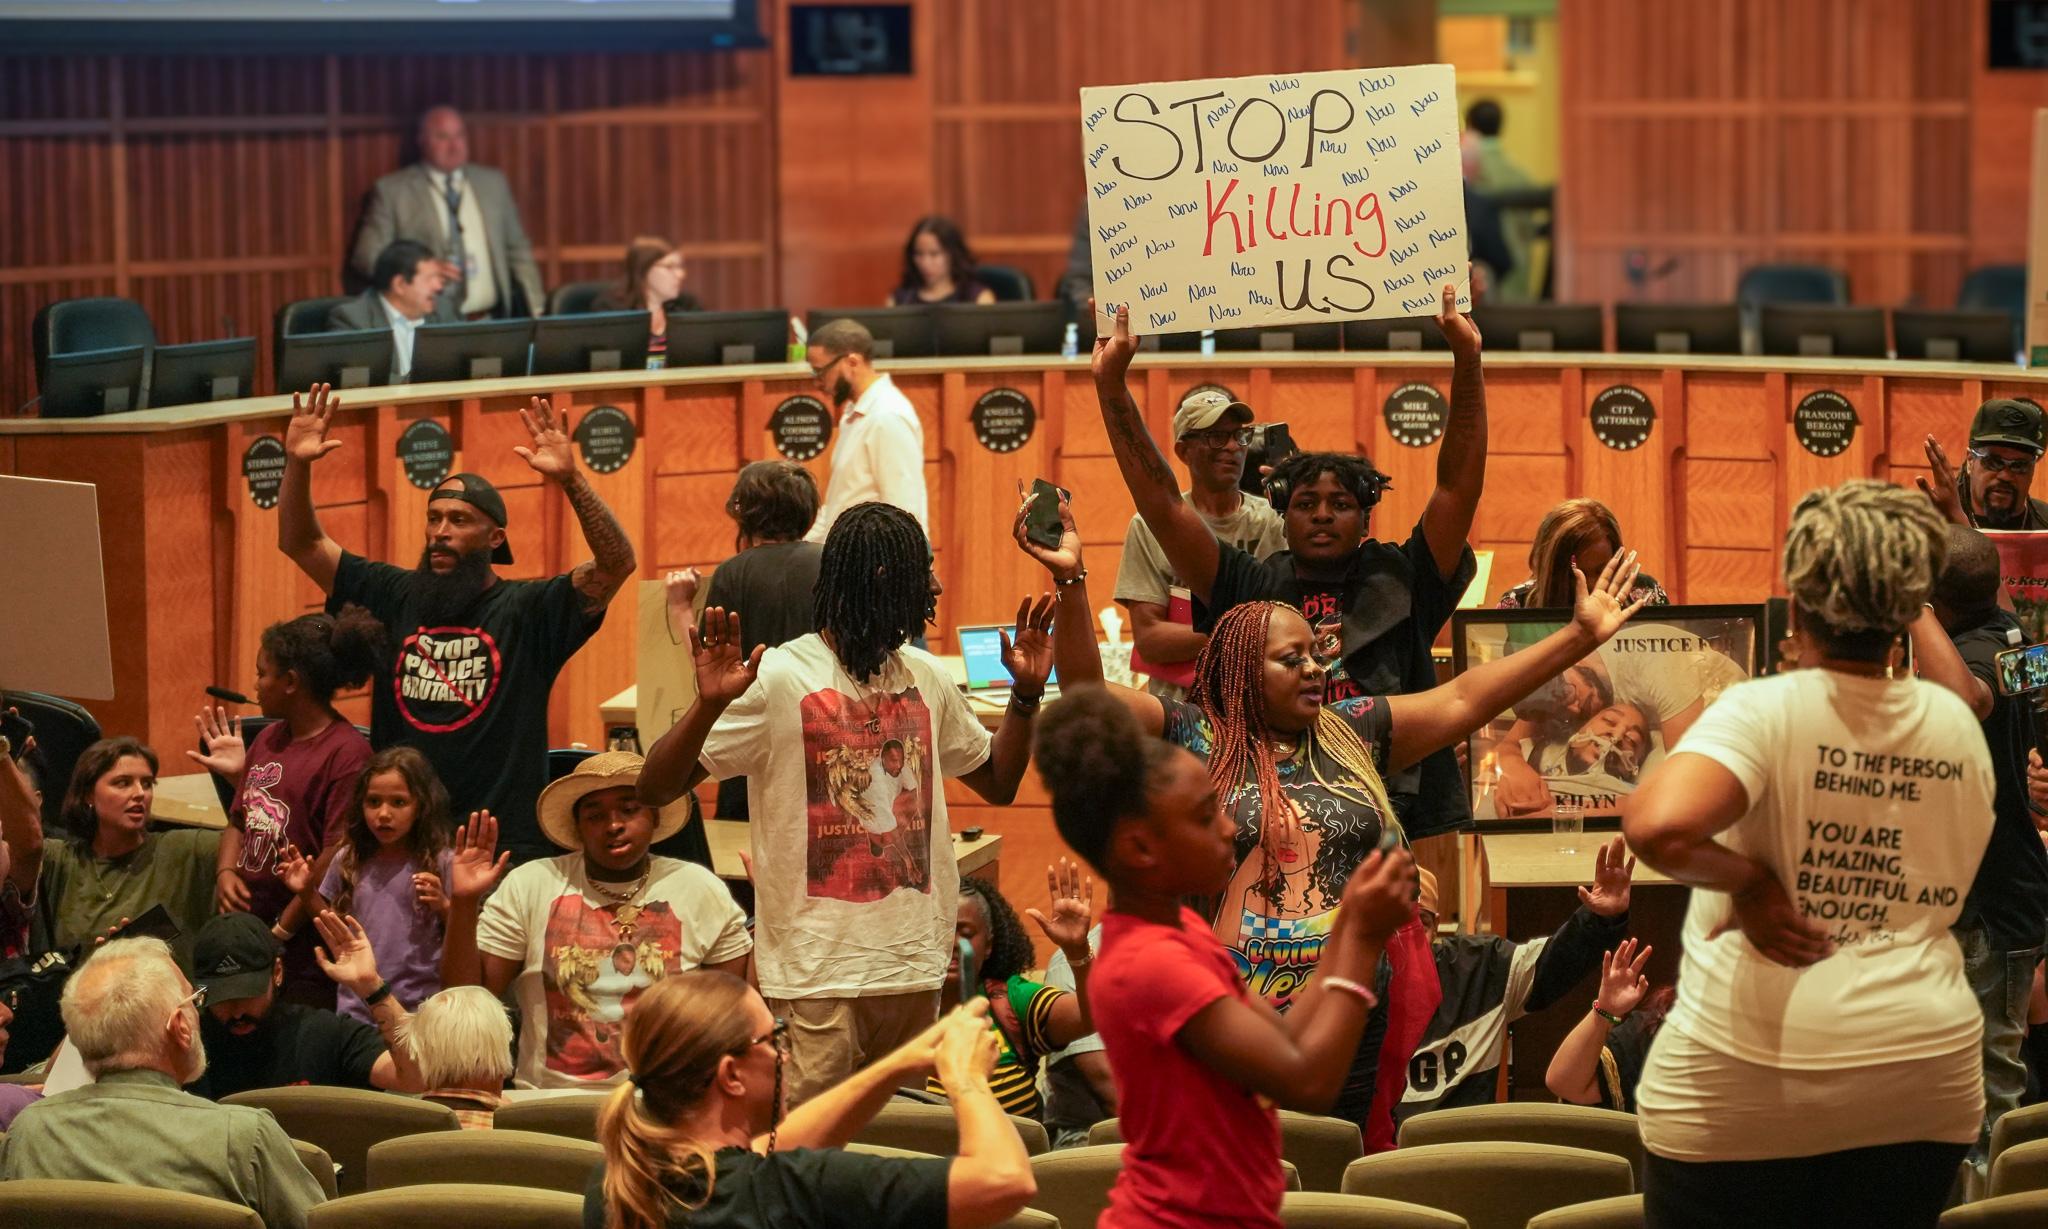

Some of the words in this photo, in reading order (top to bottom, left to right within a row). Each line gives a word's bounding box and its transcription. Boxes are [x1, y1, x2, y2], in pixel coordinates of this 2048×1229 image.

[1270, 79, 1300, 94] Now
[1360, 75, 1395, 96] Now
[1207, 98, 1235, 128] Now
[1288, 105, 1312, 123] Now
[1410, 91, 1438, 117] Now
[1085, 107, 1107, 132] Now
[1366, 103, 1395, 126] Now
[1112, 89, 1354, 181] STOP
[1089, 144, 1109, 168] Now
[1320, 140, 1346, 154] Now
[1366, 136, 1396, 156] Now
[1413, 139, 1442, 164] Now
[1213, 160, 1238, 174] Now
[1264, 164, 1288, 177] Now
[1342, 167, 1369, 186] Now
[1094, 181, 1117, 199] Now
[1389, 180, 1418, 202] Now
[1124, 193, 1152, 211] Now
[1168, 201, 1198, 219] Now
[1203, 179, 1387, 257] Killing
[1394, 211, 1426, 233] Now
[1098, 221, 1126, 243] Now
[1428, 227, 1457, 248] Now
[1110, 235, 1138, 259] Now
[1146, 240, 1175, 259] Now
[1389, 243, 1419, 266] Now
[1105, 263, 1132, 284] Now
[1231, 262, 1255, 276] Now
[1423, 264, 1456, 285] Now
[1140, 282, 1167, 301] Now
[1383, 274, 1415, 293] Now
[1189, 285, 1216, 303] Now
[1249, 290, 1272, 305] Now
[1402, 293, 1435, 313] Now
[1455, 295, 1468, 306] ow
[1150, 311, 1176, 328] Now
[1209, 304, 1241, 322] Now
[1402, 402, 1429, 411] MIKE
[1611, 405, 1635, 415] CITY
[1799, 410, 1852, 420] FRANÇOISE
[1391, 412, 1440, 422] COFFMAN
[1597, 415, 1648, 426] ATTORNEY
[1806, 420, 1846, 431] BERGAN
[418, 634, 480, 660] STOP
[1613, 638, 1691, 653] JUSTICE
[404, 653, 487, 680] POLICE
[402, 674, 487, 702] BRUTALITY
[1817, 745, 1847, 767] TO
[1853, 752, 1886, 773] THE
[1889, 757, 1963, 781] PERSON
[1814, 770, 1885, 798] BEHIND
[1555, 794, 1617, 809] KILYN
[1807, 819, 1857, 844] YOU
[1860, 826, 1902, 849] ARE
[1800, 847, 1906, 880] AMAZING,
[1797, 871, 1909, 902] BEAUTIFUL
[1916, 886, 1958, 907] AND
